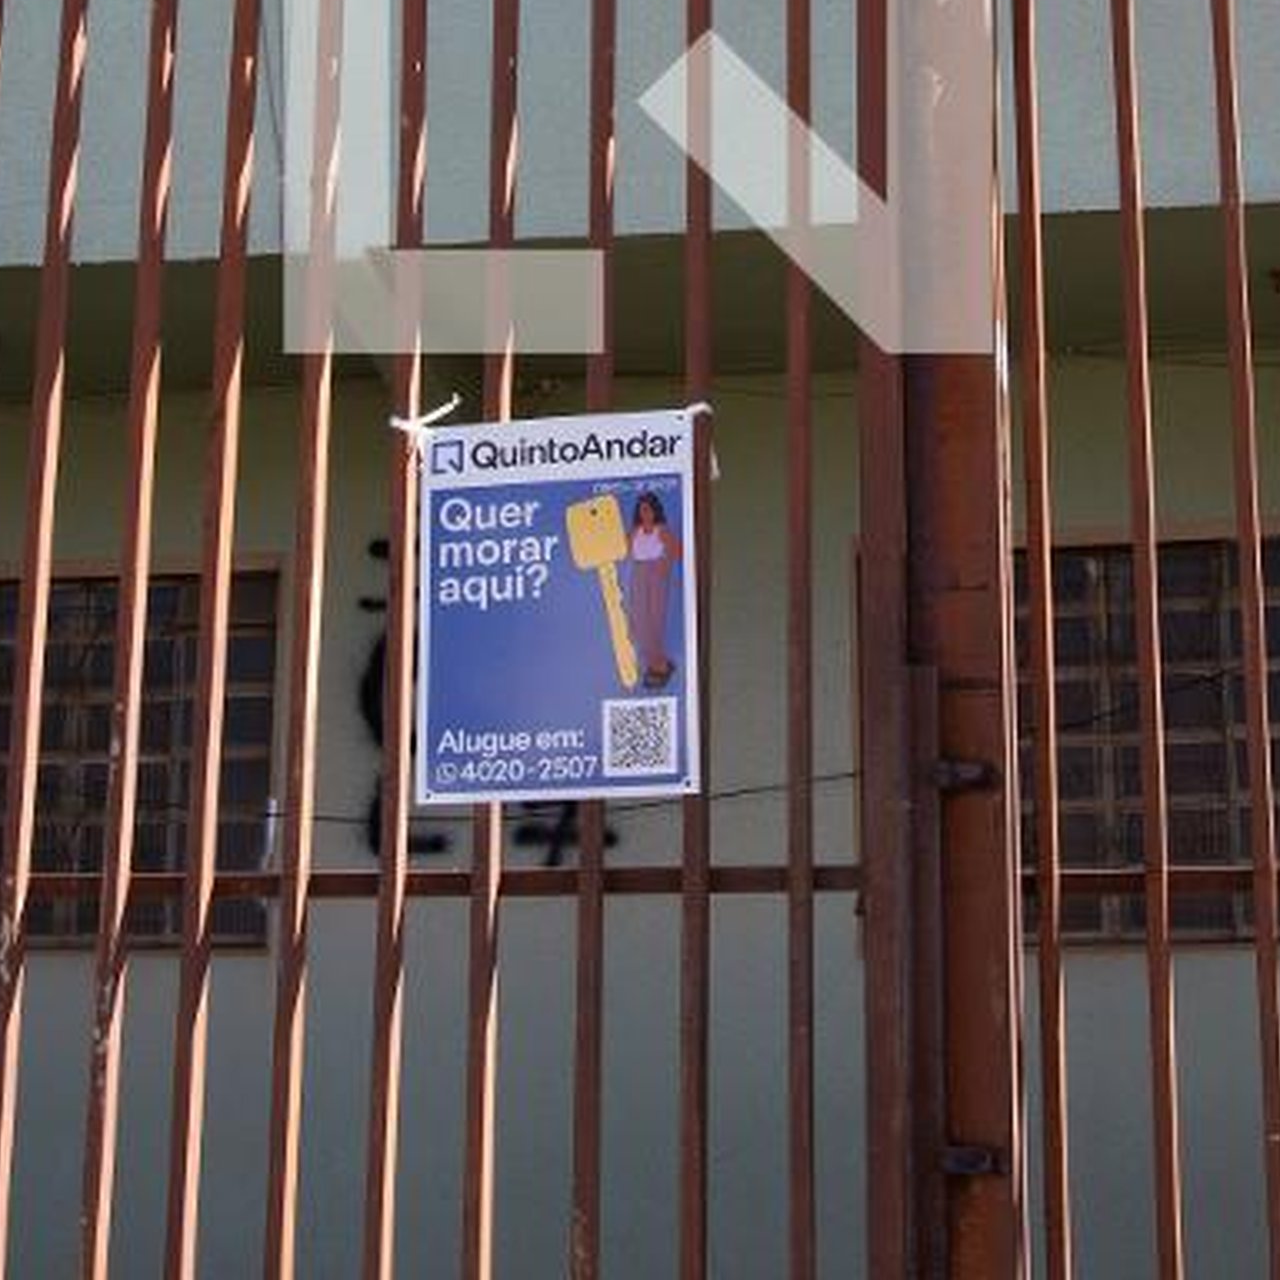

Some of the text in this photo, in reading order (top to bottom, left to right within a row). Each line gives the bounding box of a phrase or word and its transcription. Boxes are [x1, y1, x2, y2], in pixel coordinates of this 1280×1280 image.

[471, 430, 682, 470] QuintoAndar
[439, 498, 540, 533] Quer
[438, 534, 559, 569] morar
[438, 566, 548, 611] aqui?
[437, 728, 585, 758] Alugue em:
[460, 756, 598, 782] 4020-2507
